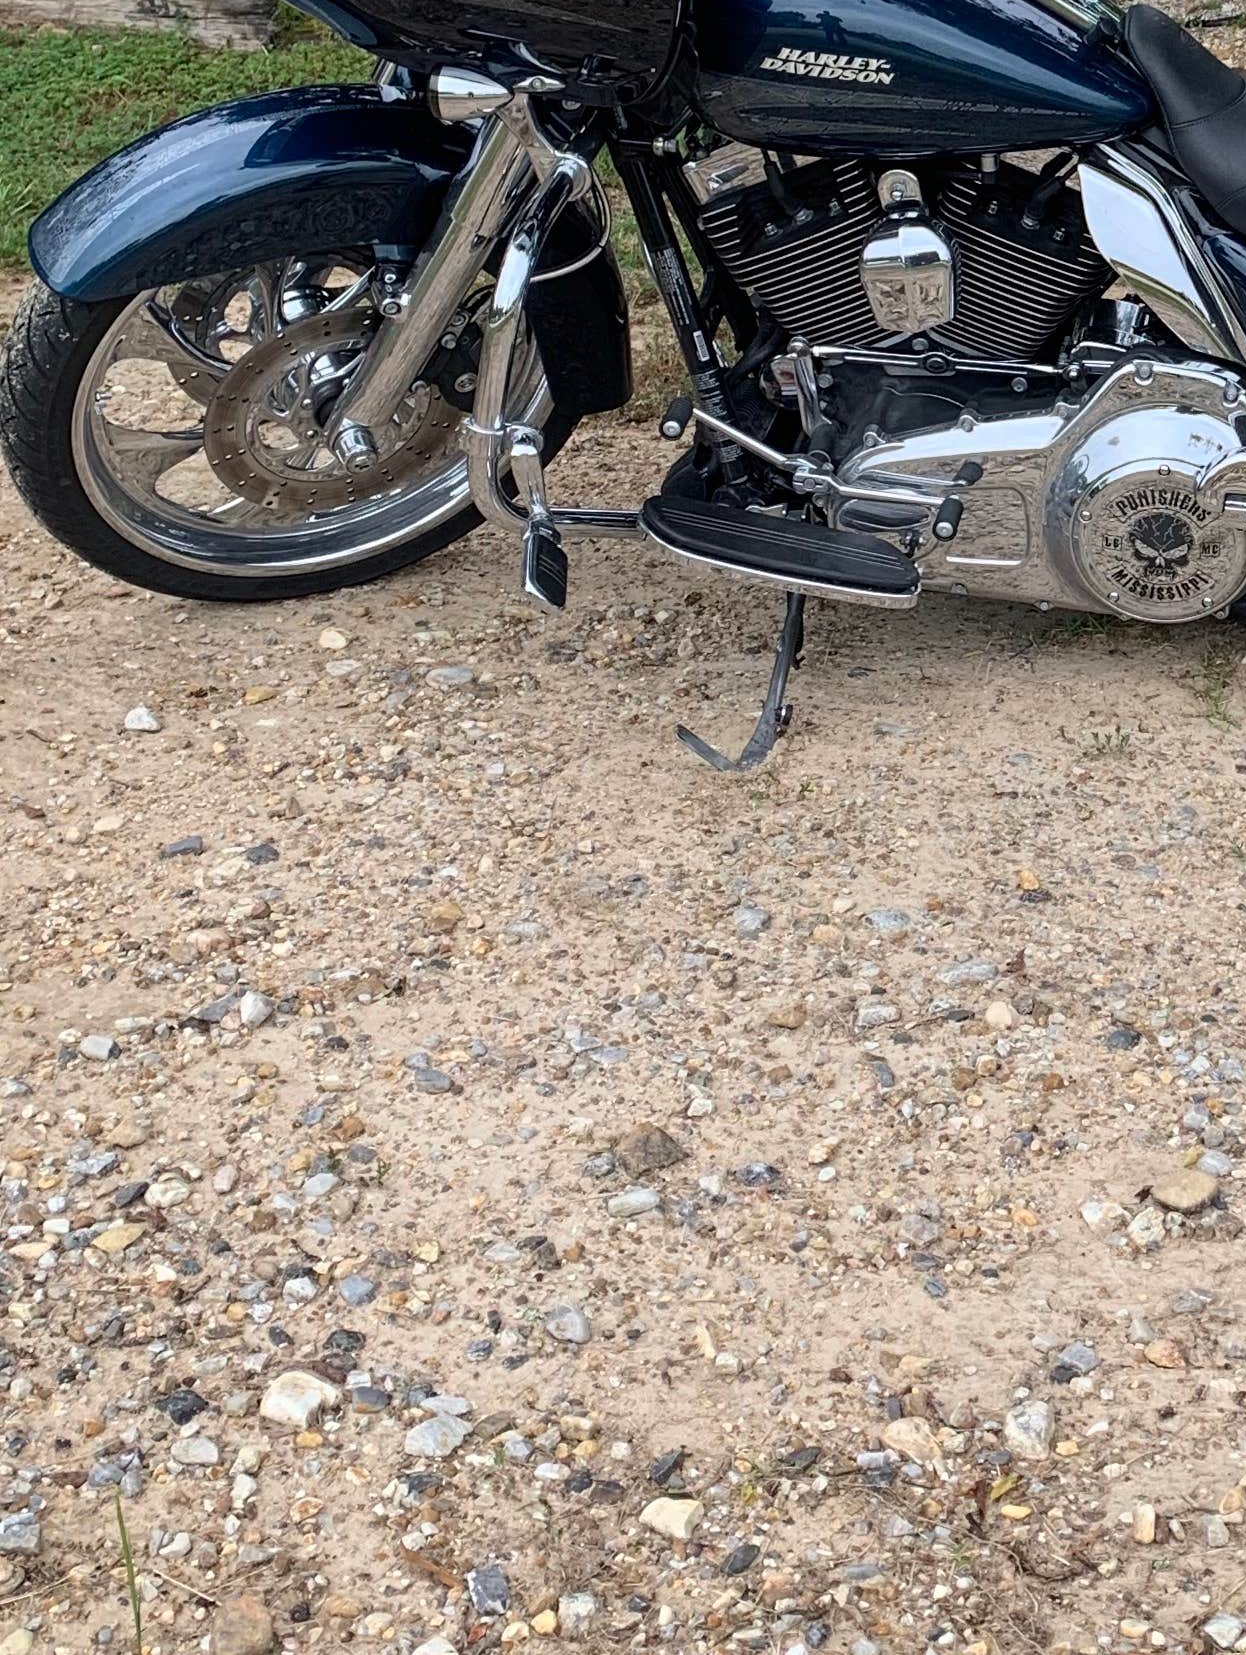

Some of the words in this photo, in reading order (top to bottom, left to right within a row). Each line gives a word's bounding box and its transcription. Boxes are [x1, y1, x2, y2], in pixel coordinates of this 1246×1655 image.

[760, 57, 895, 85] DAVIDSON
[776, 47, 891, 70] HARLEY-
[1115, 489, 1211, 522] PUNISHERS
[1202, 544, 1219, 555] MC
[1111, 568, 1209, 600] MISSISSIPPI
